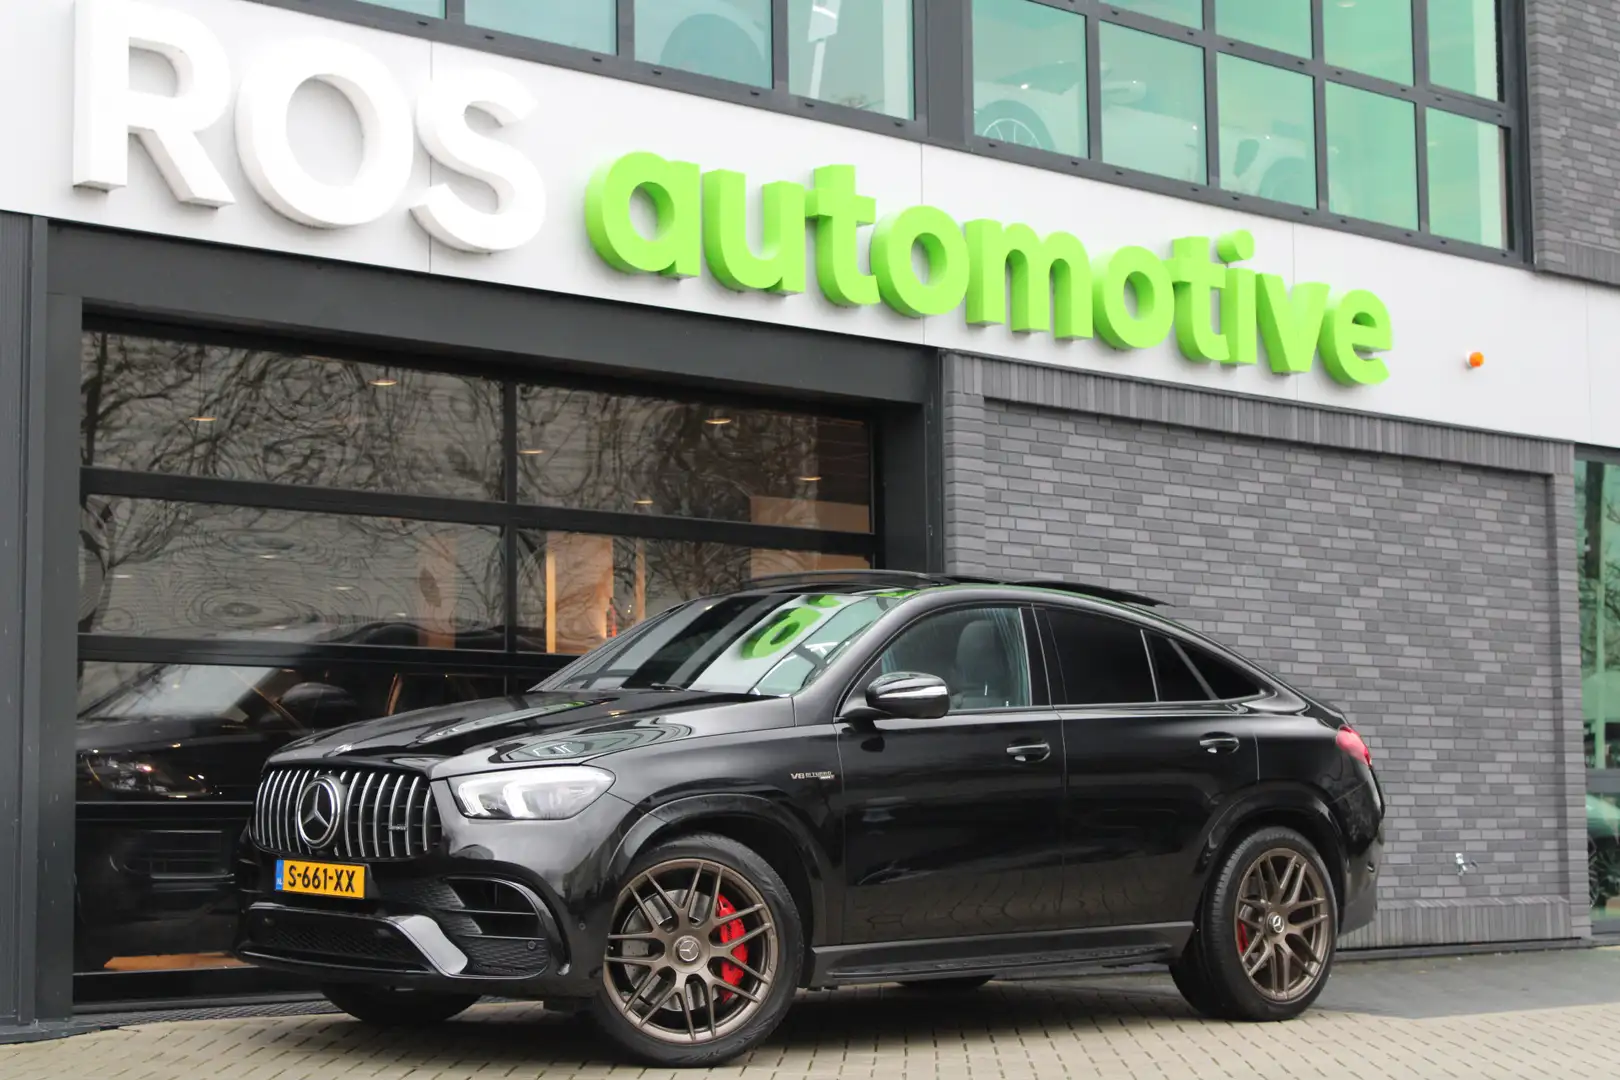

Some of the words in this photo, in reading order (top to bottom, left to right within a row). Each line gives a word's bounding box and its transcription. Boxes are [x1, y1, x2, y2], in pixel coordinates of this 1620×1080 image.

[73, 0, 546, 253] ROS
[584, 151, 1394, 386] automotive
[791, 772, 805, 780] V8
[288, 865, 355, 893] S-661-XX
